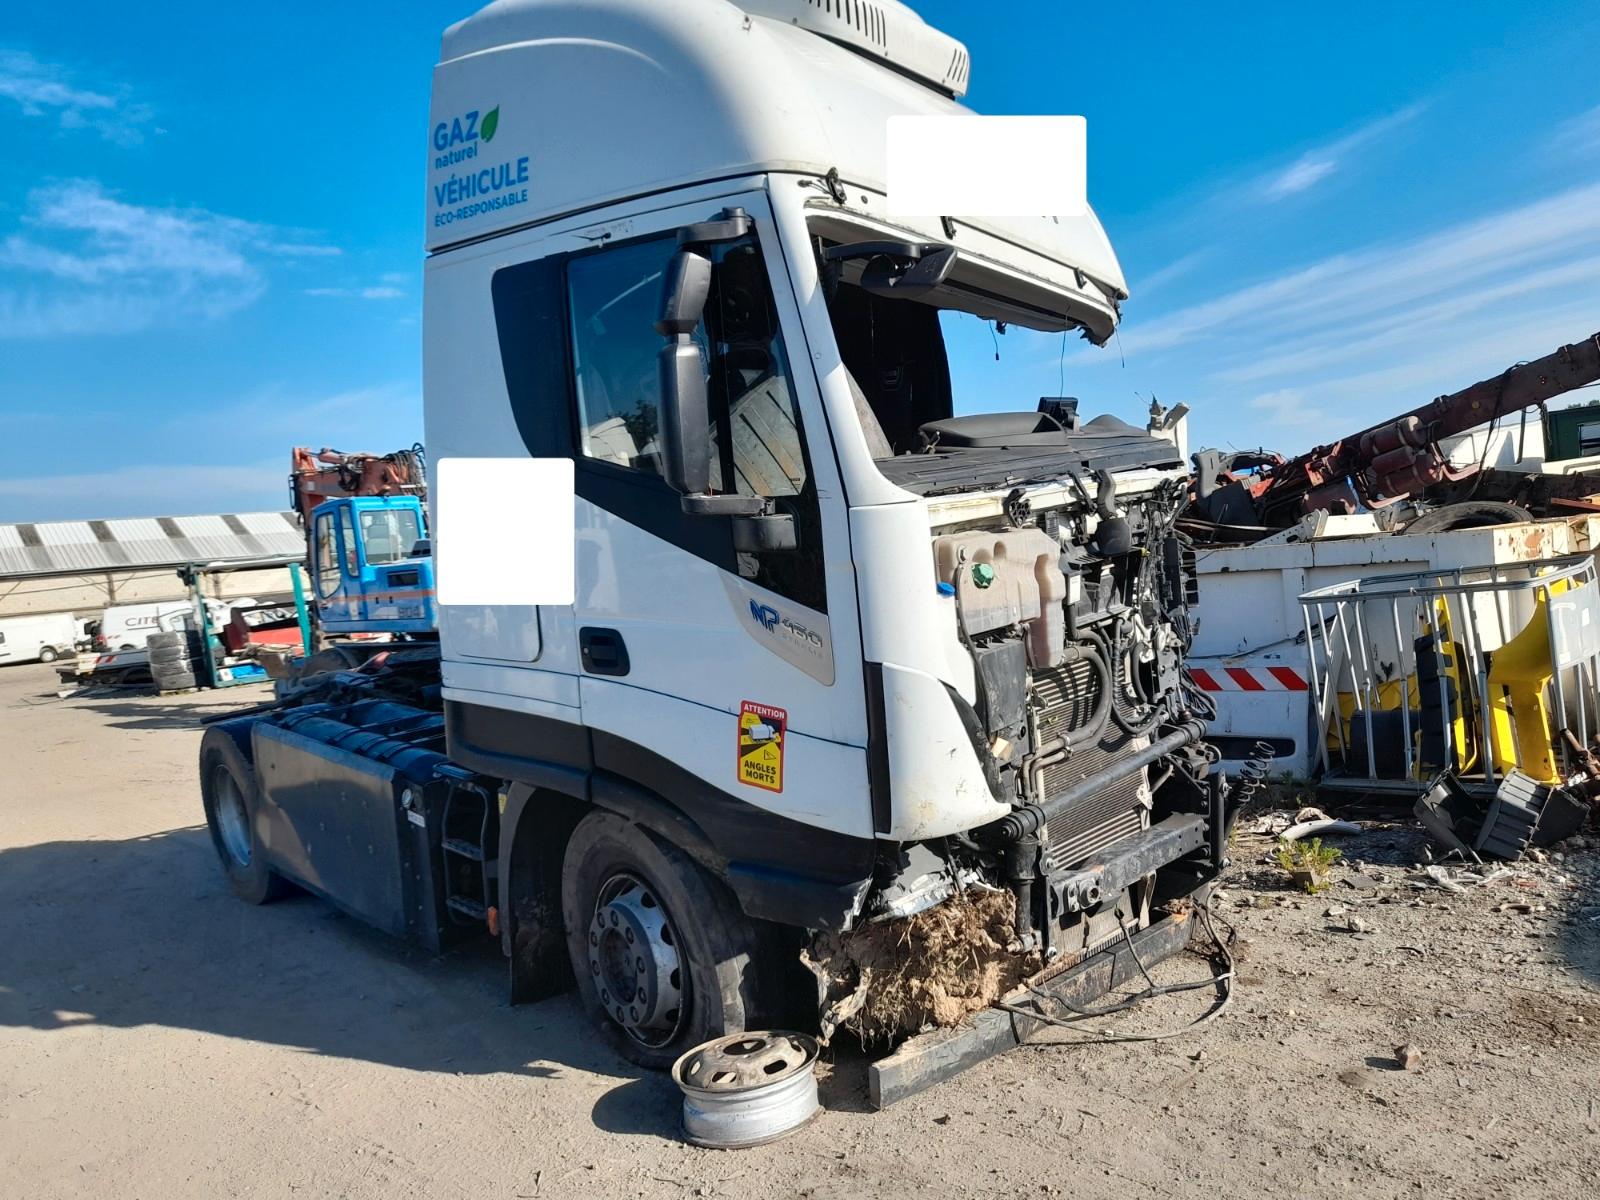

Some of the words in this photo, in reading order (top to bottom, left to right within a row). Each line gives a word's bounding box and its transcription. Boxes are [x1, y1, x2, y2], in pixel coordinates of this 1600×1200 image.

[434, 111, 480, 151] GAZ
[435, 142, 478, 170] naturel
[434, 157, 529, 207] VÉHICULE
[434, 189, 528, 227] ÉCO-RESPONSABLE
[743, 703, 785, 719] ATTENTION
[744, 760, 776, 775] ANGLES
[745, 769, 775, 784] MORTS
